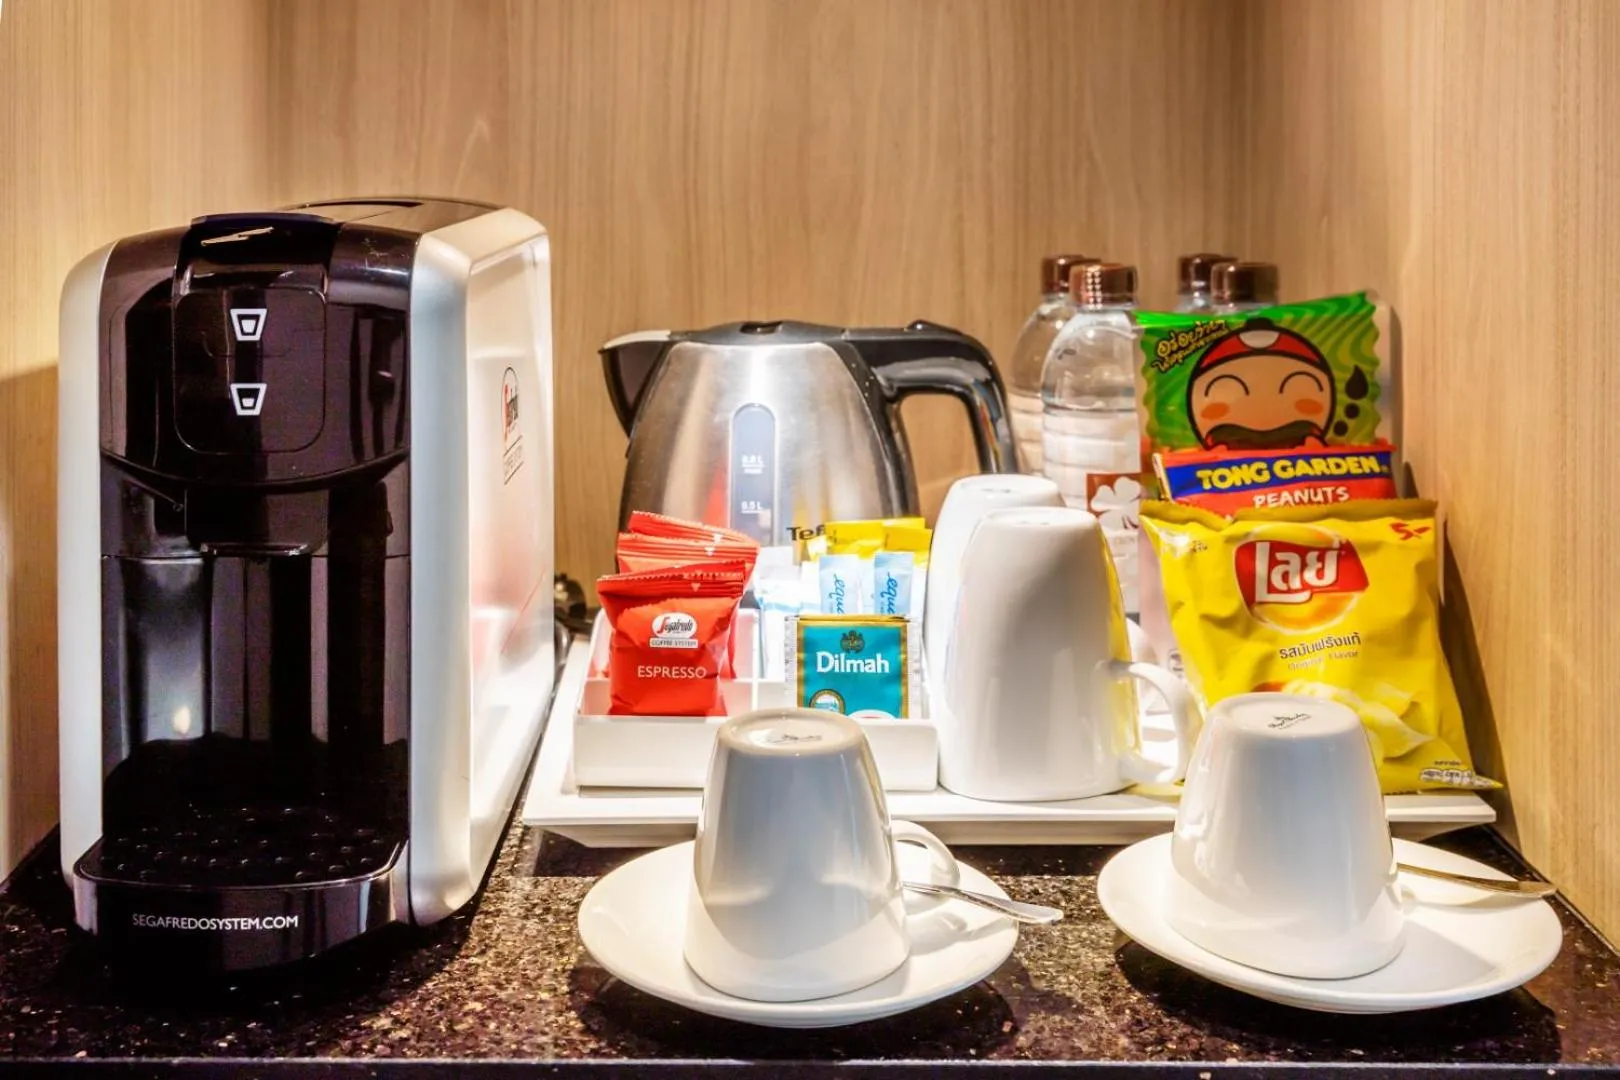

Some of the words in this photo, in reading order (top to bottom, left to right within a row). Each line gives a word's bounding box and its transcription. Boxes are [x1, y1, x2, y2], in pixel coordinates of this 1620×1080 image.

[1196, 461, 1271, 490] TONG
[1273, 456, 1381, 479] GARDEN
[1253, 487, 1349, 508] PEANUTS
[637, 665, 707, 679] ESPRESSO
[816, 651, 890, 673] Dilmah
[132, 913, 299, 930] SEGAFREDOSYSTEM.COM
